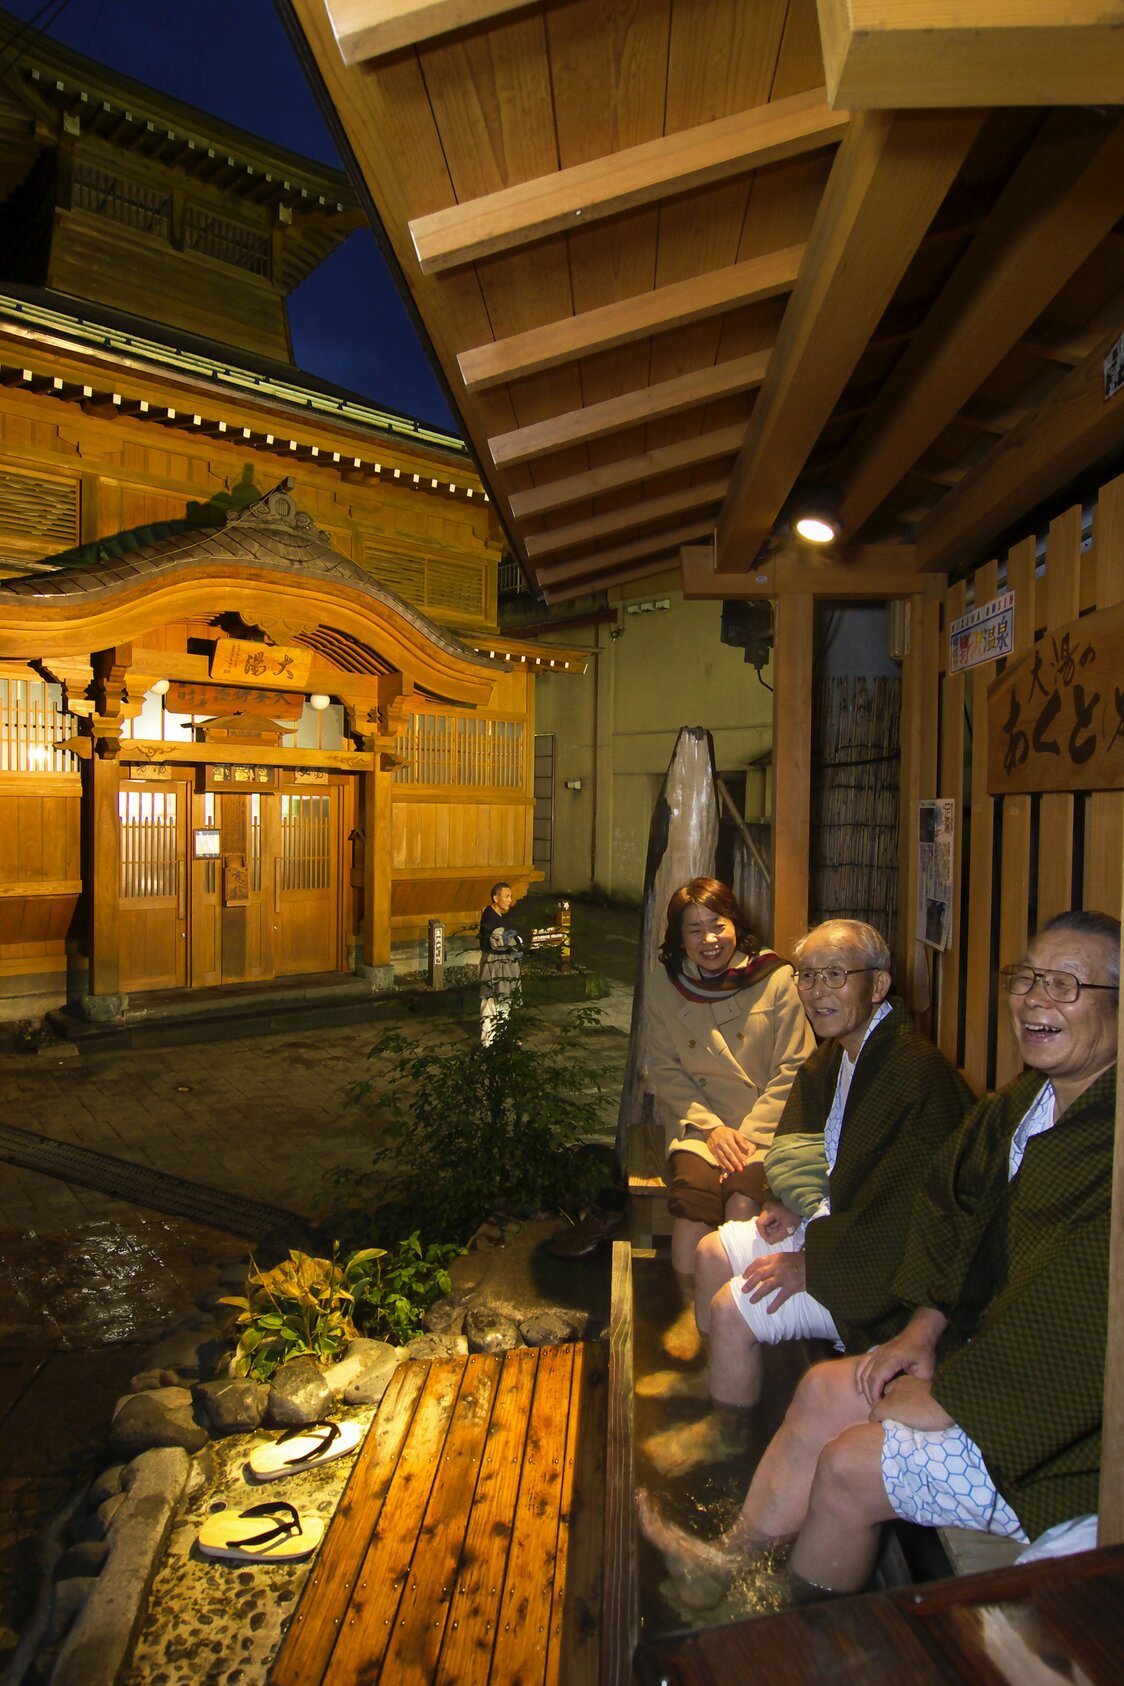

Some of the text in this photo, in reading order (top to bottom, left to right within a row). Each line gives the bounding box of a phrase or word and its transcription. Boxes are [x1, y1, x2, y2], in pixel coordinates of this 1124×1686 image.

[244, 651, 294, 680] 大湯
[1028, 632, 1096, 704] 大湯の
